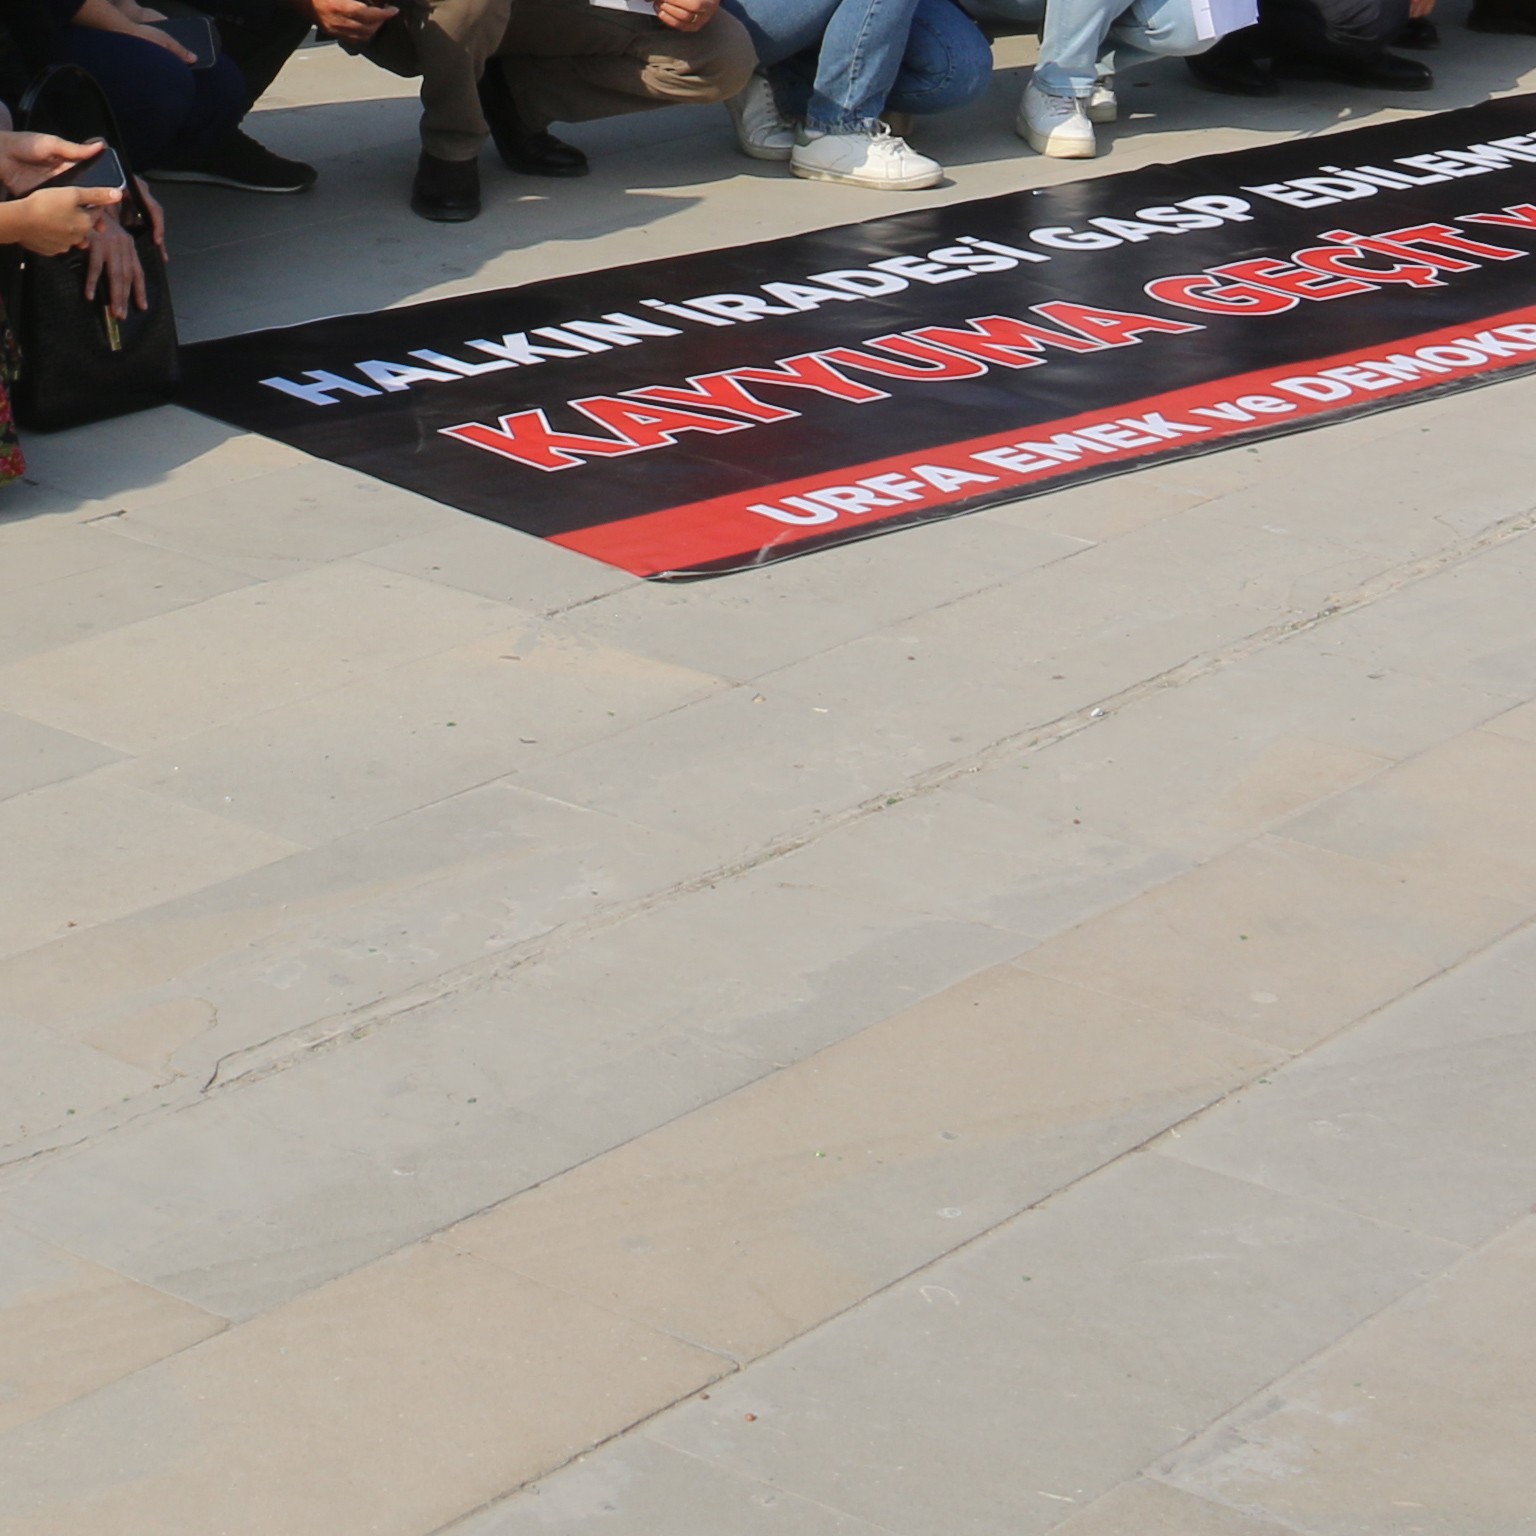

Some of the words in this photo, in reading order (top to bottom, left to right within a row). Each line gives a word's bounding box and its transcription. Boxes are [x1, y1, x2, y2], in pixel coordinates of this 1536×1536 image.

[258, 311, 684, 407] HALKIN
[639, 235, 1052, 328] İRADESİ
[1028, 194, 1255, 251] GASP
[436, 299, 1207, 473] KAYYUMA
[1143, 222, 1529, 316] GEÇİT
[746, 464, 1001, 528] URFA
[969, 411, 1213, 475] EMEK
[1189, 393, 1298, 423] ve
